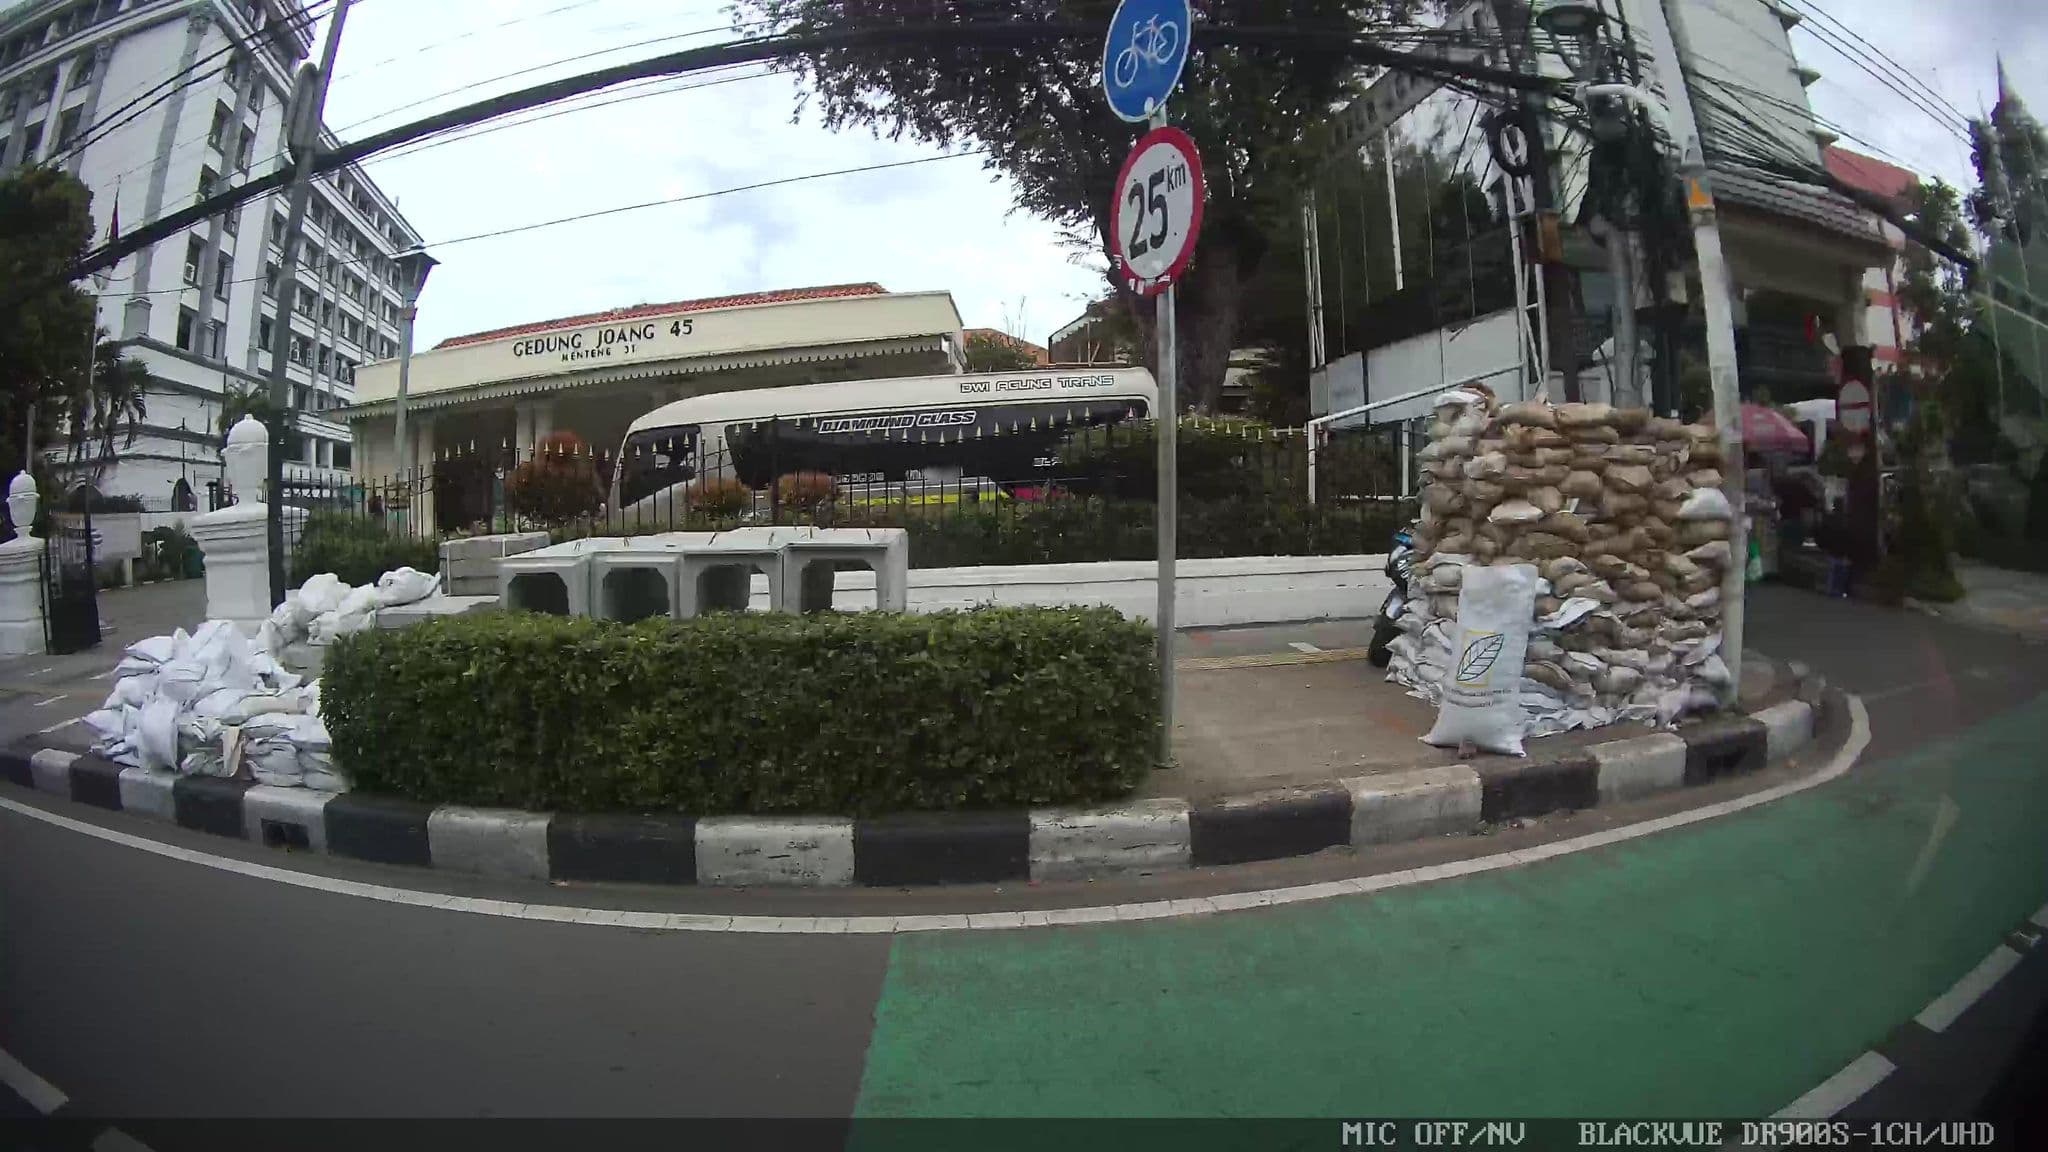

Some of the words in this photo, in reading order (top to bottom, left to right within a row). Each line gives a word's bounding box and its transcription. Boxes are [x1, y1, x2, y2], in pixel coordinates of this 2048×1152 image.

[1128, 168, 1169, 260] 25
[1167, 163, 1187, 191] km
[513, 333, 582, 357] GEDUNG
[596, 324, 655, 349] JOANG
[670, 319, 694, 337] 45
[561, 347, 611, 362] MENTENG
[960, 381, 990, 393] DWI
[996, 378, 1052, 391] AGUNG
[1058, 375, 1115, 388] TRANS
[917, 411, 977, 427] CLASS
